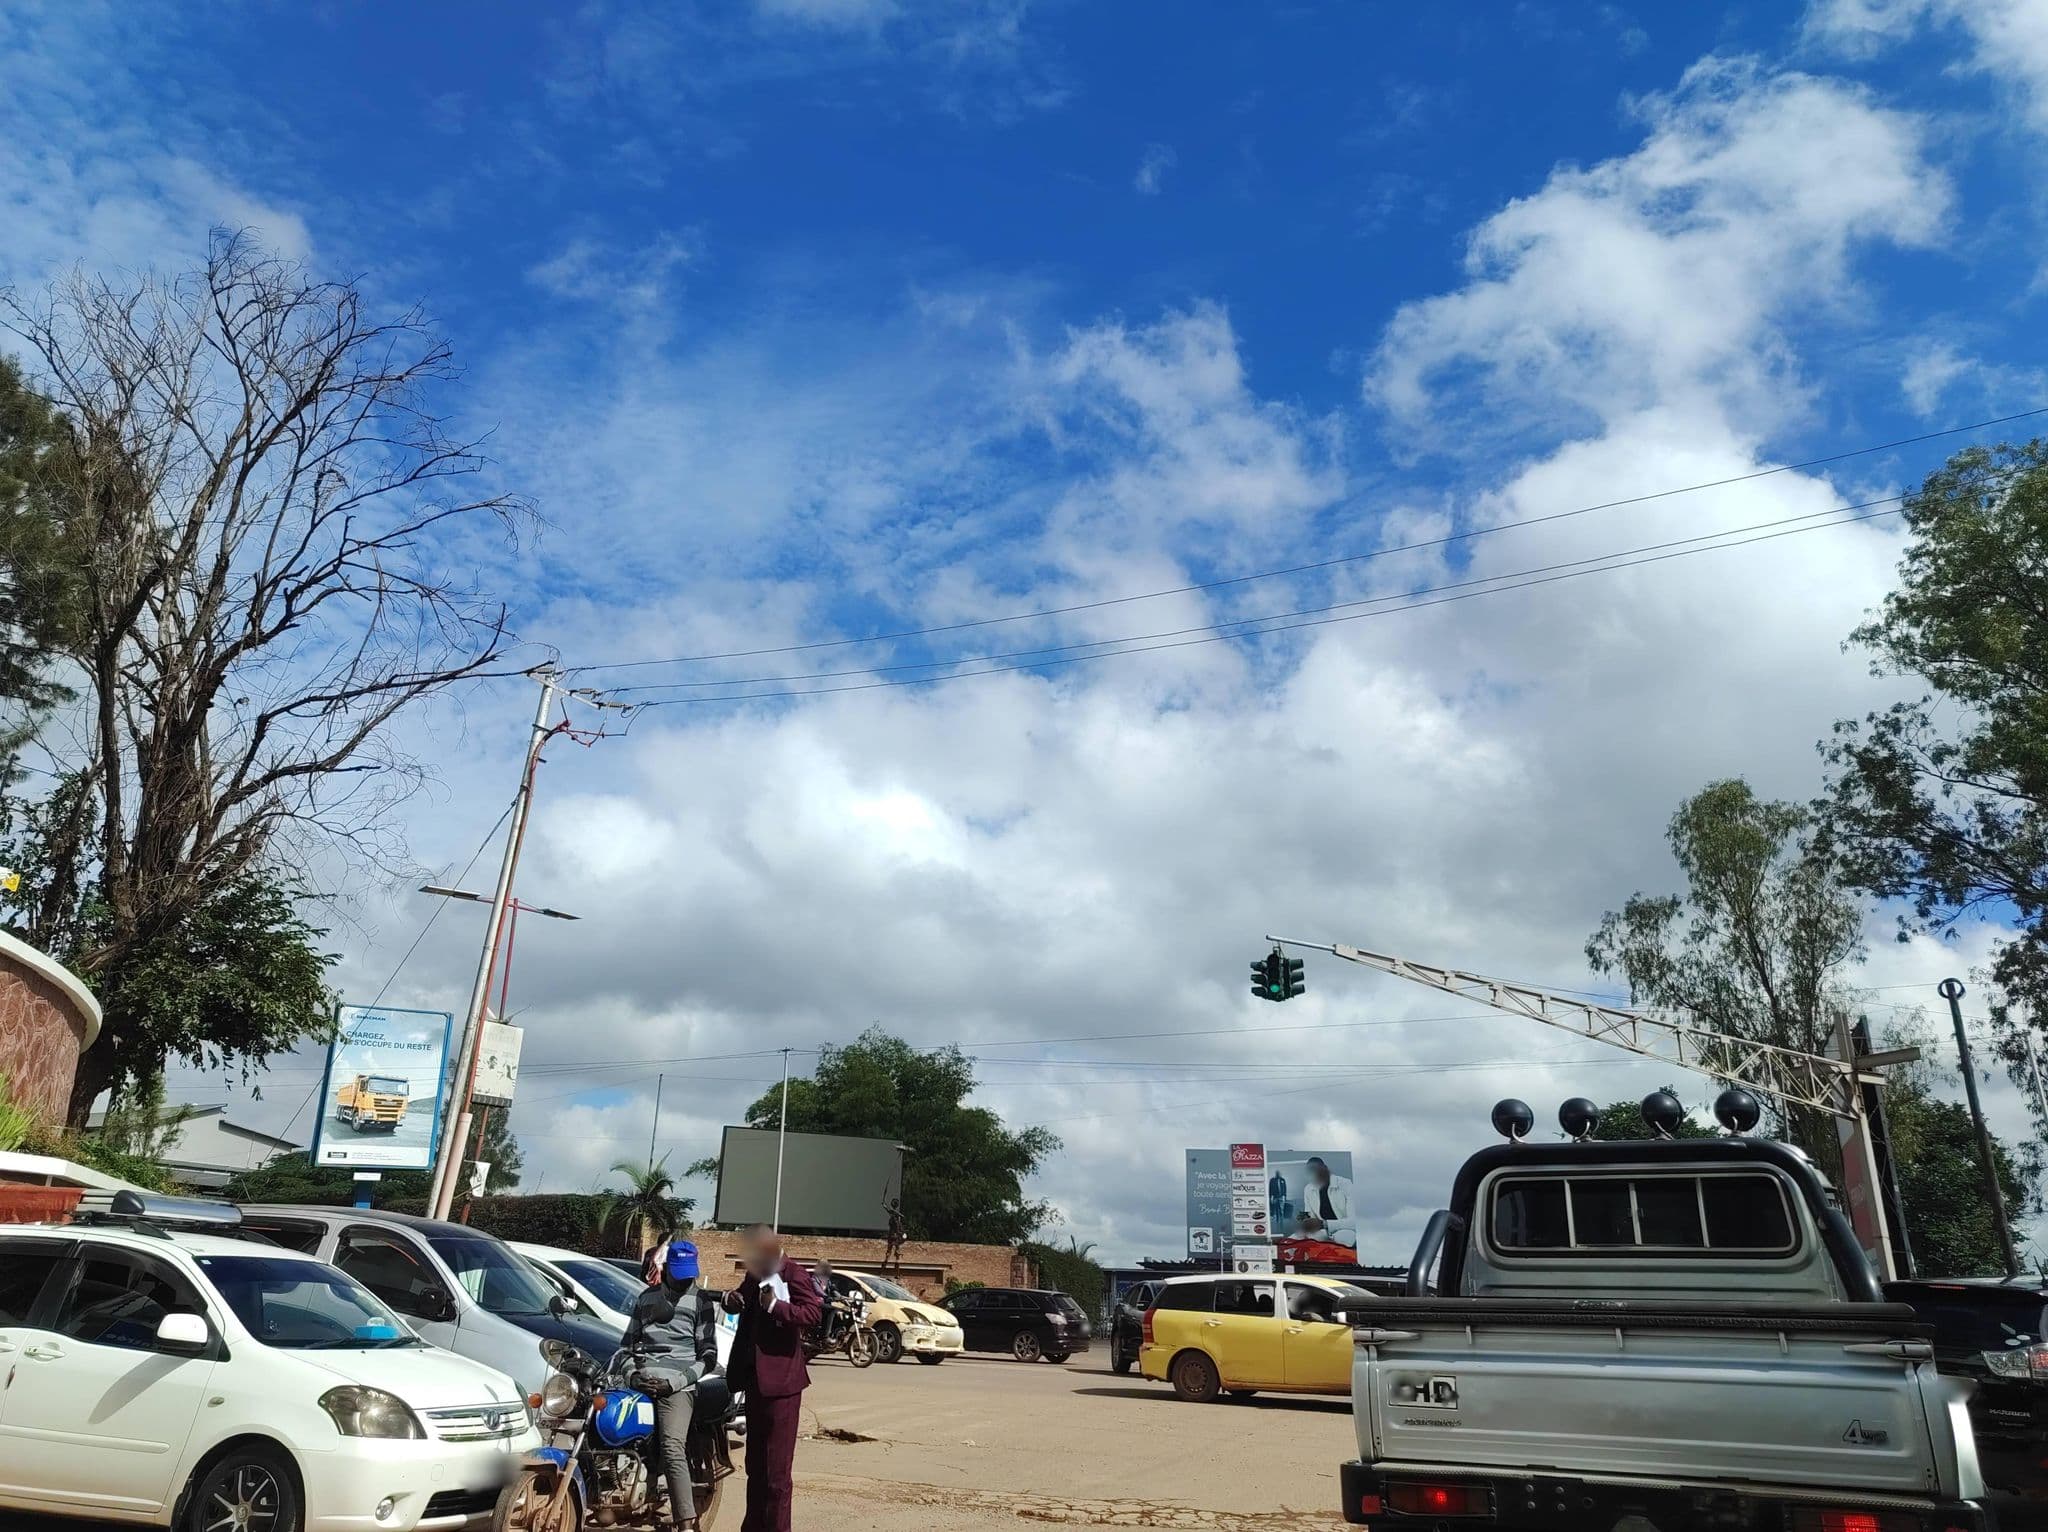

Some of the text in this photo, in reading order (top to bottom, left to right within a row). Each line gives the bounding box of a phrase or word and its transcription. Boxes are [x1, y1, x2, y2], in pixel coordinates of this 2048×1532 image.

[345, 1031, 386, 1041] CHARGEZ,
[406, 1043, 432, 1051] RESTE
[1232, 1184, 1256, 1192] NEXUS
